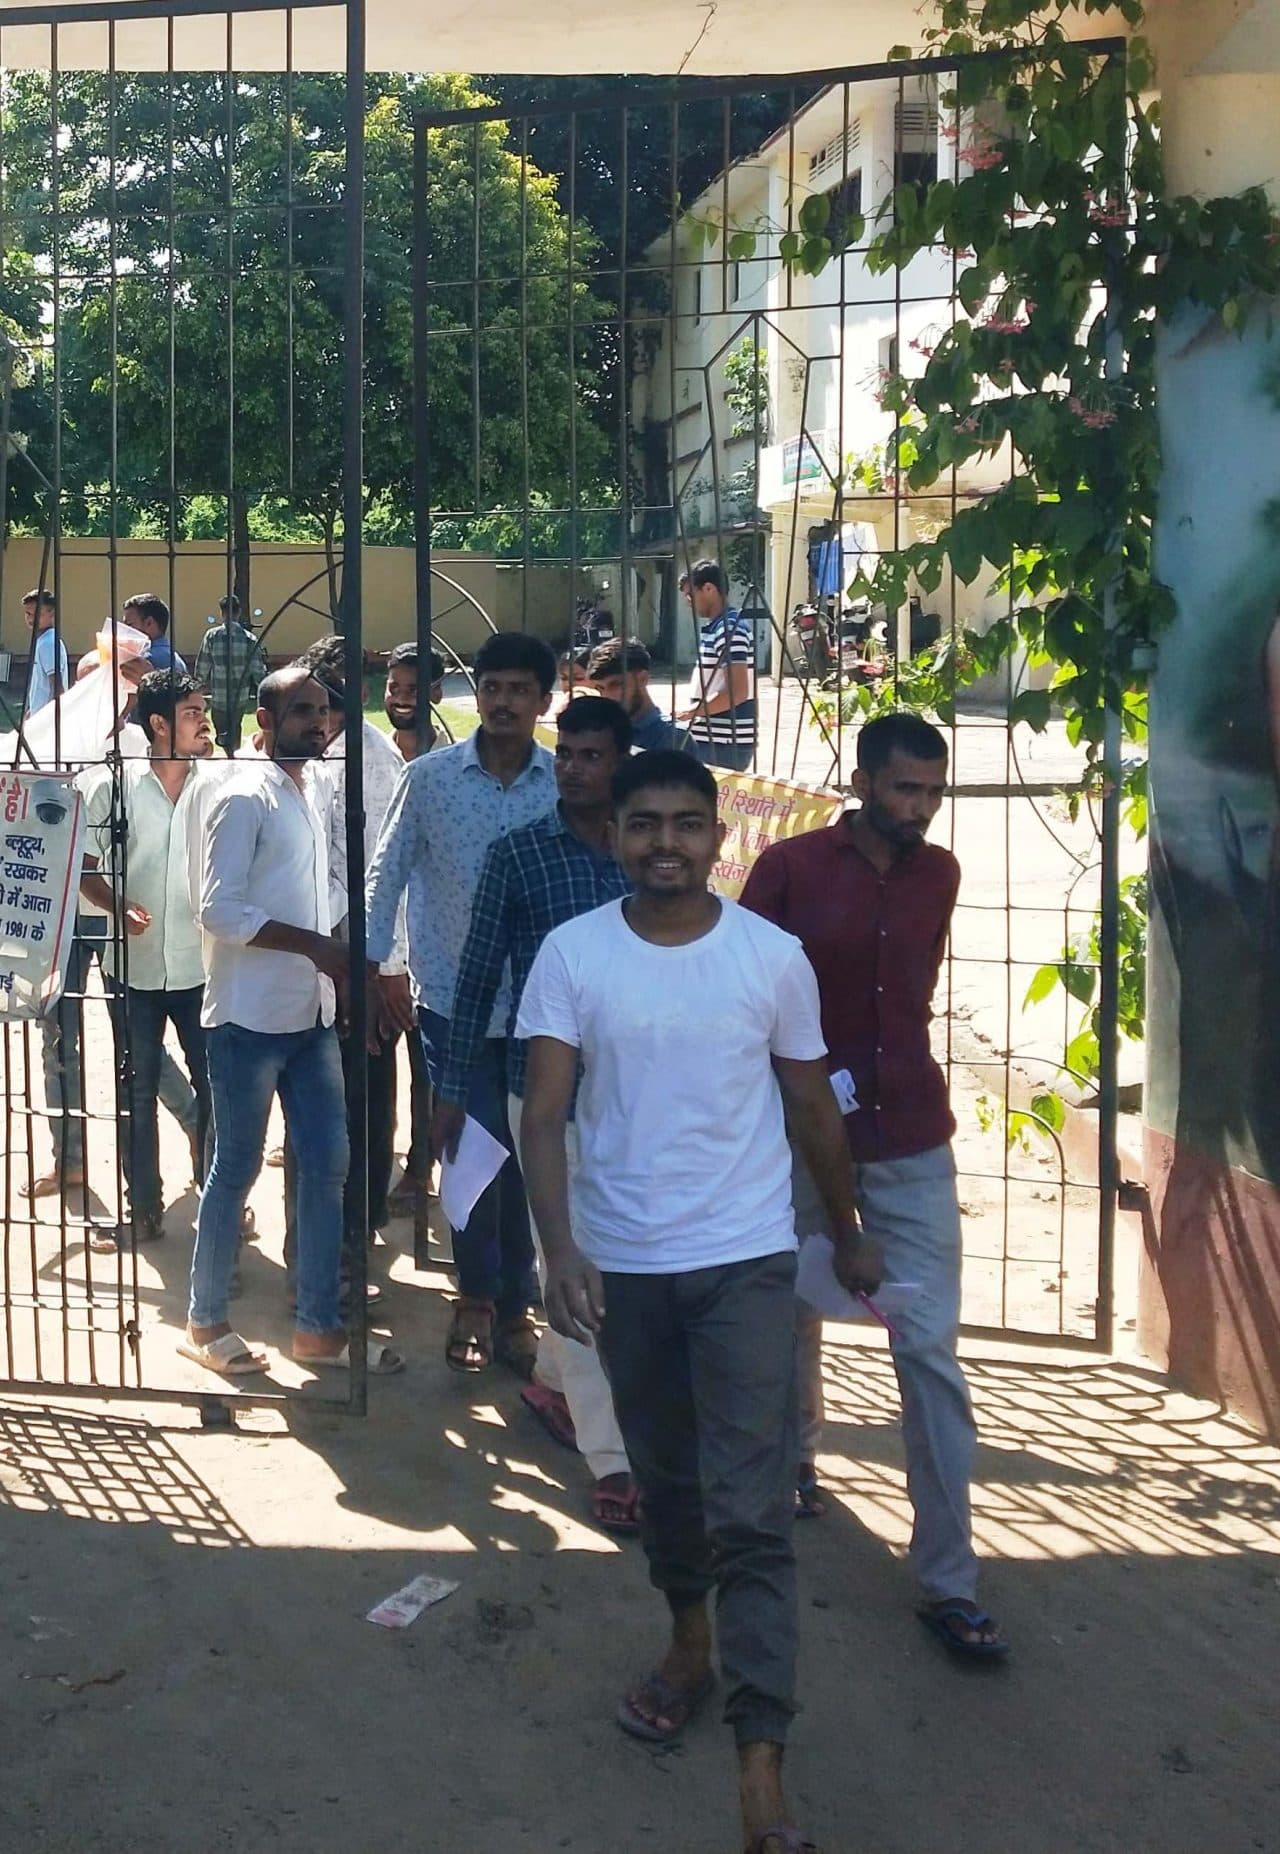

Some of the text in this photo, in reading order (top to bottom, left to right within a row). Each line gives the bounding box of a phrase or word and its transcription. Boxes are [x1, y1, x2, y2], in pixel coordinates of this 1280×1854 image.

[779, 797, 796, 822] में
[4, 862, 48, 883] रखकर
[7, 886, 23, 907] में
[22, 894, 53, 914] आता
[6, 921, 28, 939] 1981
[30, 920, 46, 942] के
